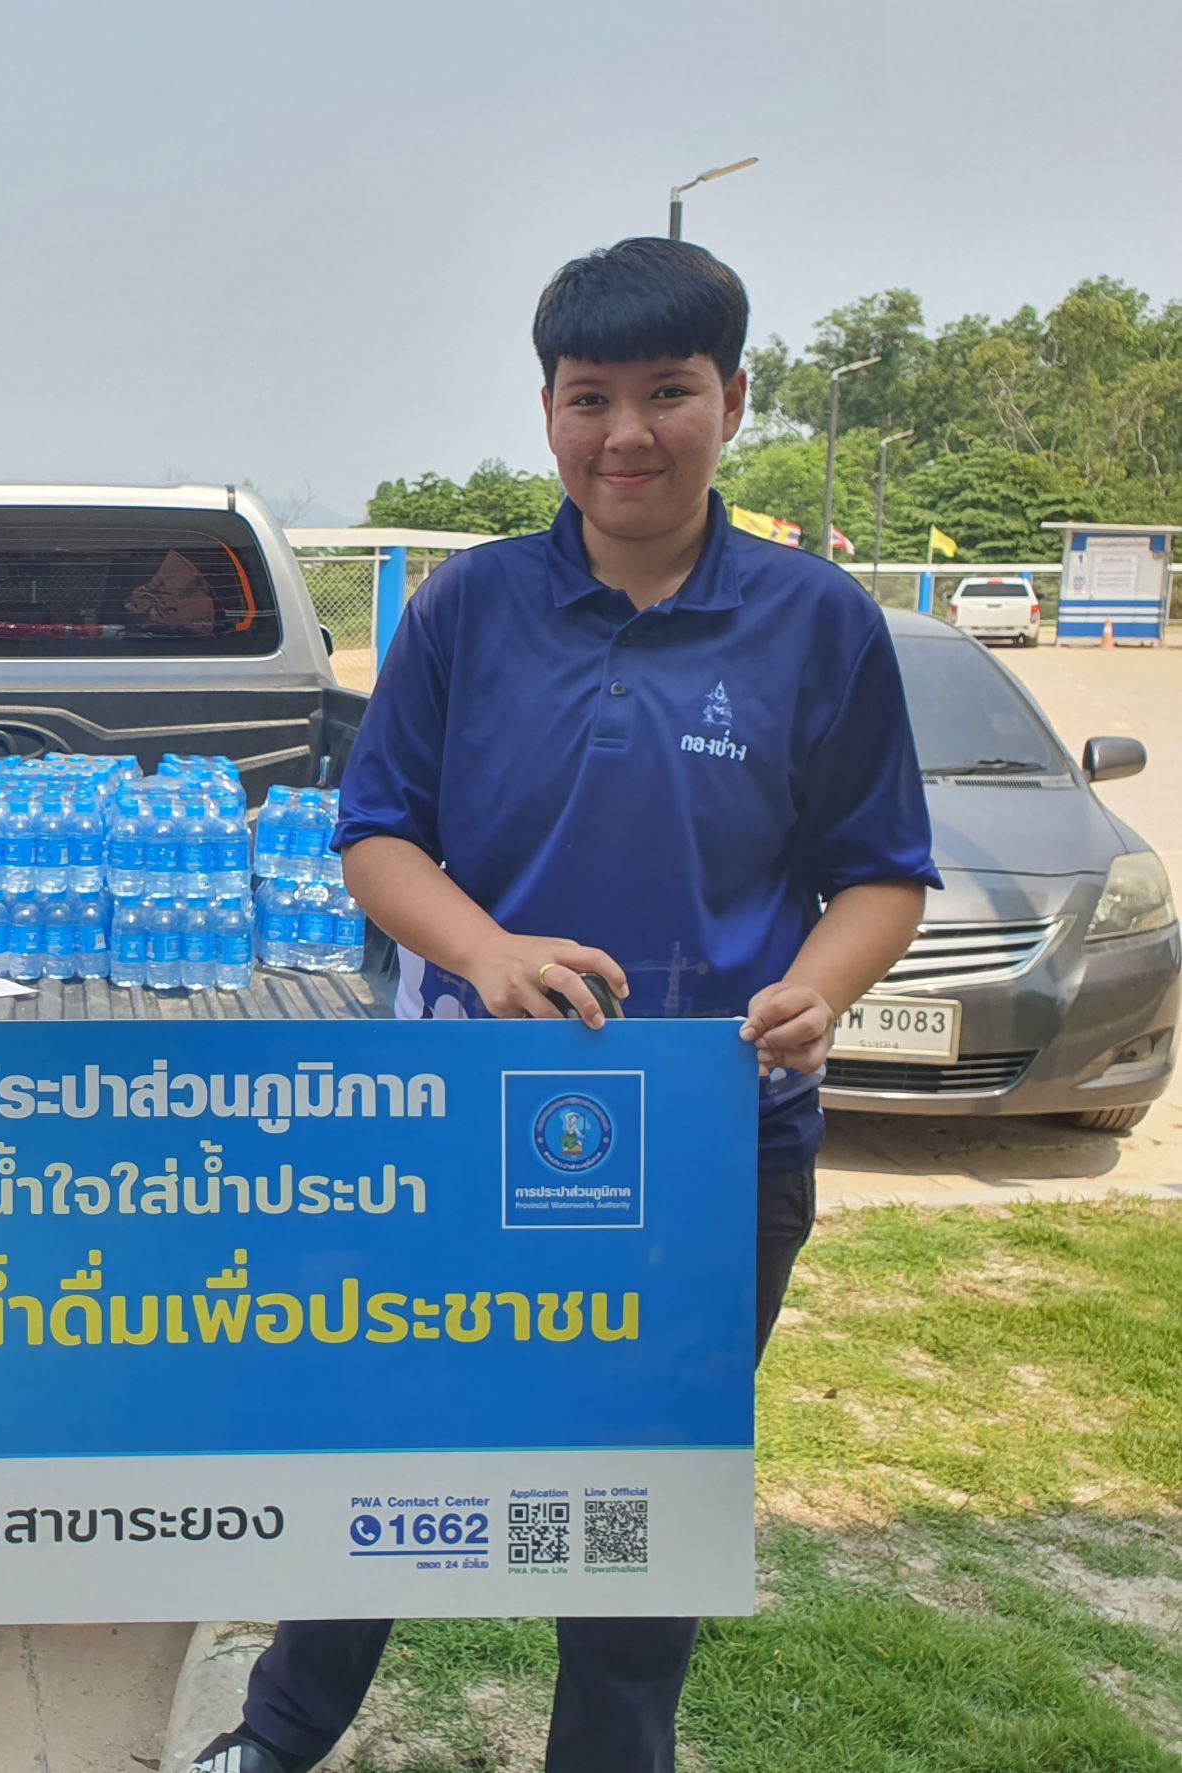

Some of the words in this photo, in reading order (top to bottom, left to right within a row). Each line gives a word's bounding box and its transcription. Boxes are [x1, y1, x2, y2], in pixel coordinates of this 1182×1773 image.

[680, 729, 747, 761] กองช่าง
[880, 1008, 946, 1034] 9083
[515, 1185, 631, 1200] การประปาส่วนภูมิภาค
[515, 1201, 549, 1209] Provincial
[552, 1201, 594, 1209] Waterworks
[596, 1200, 630, 1210] Authority
[510, 1488, 569, 1499] Application
[584, 1487, 607, 1497] Line
[610, 1487, 648, 1497] Official
[351, 1497, 382, 1508] PWA
[387, 1496, 440, 1508] Contact
[445, 1496, 490, 1507] Center
[389, 1512, 489, 1545] 1662
[445, 1560, 459, 1569] 24
[551, 1566, 568, 1574] Life
